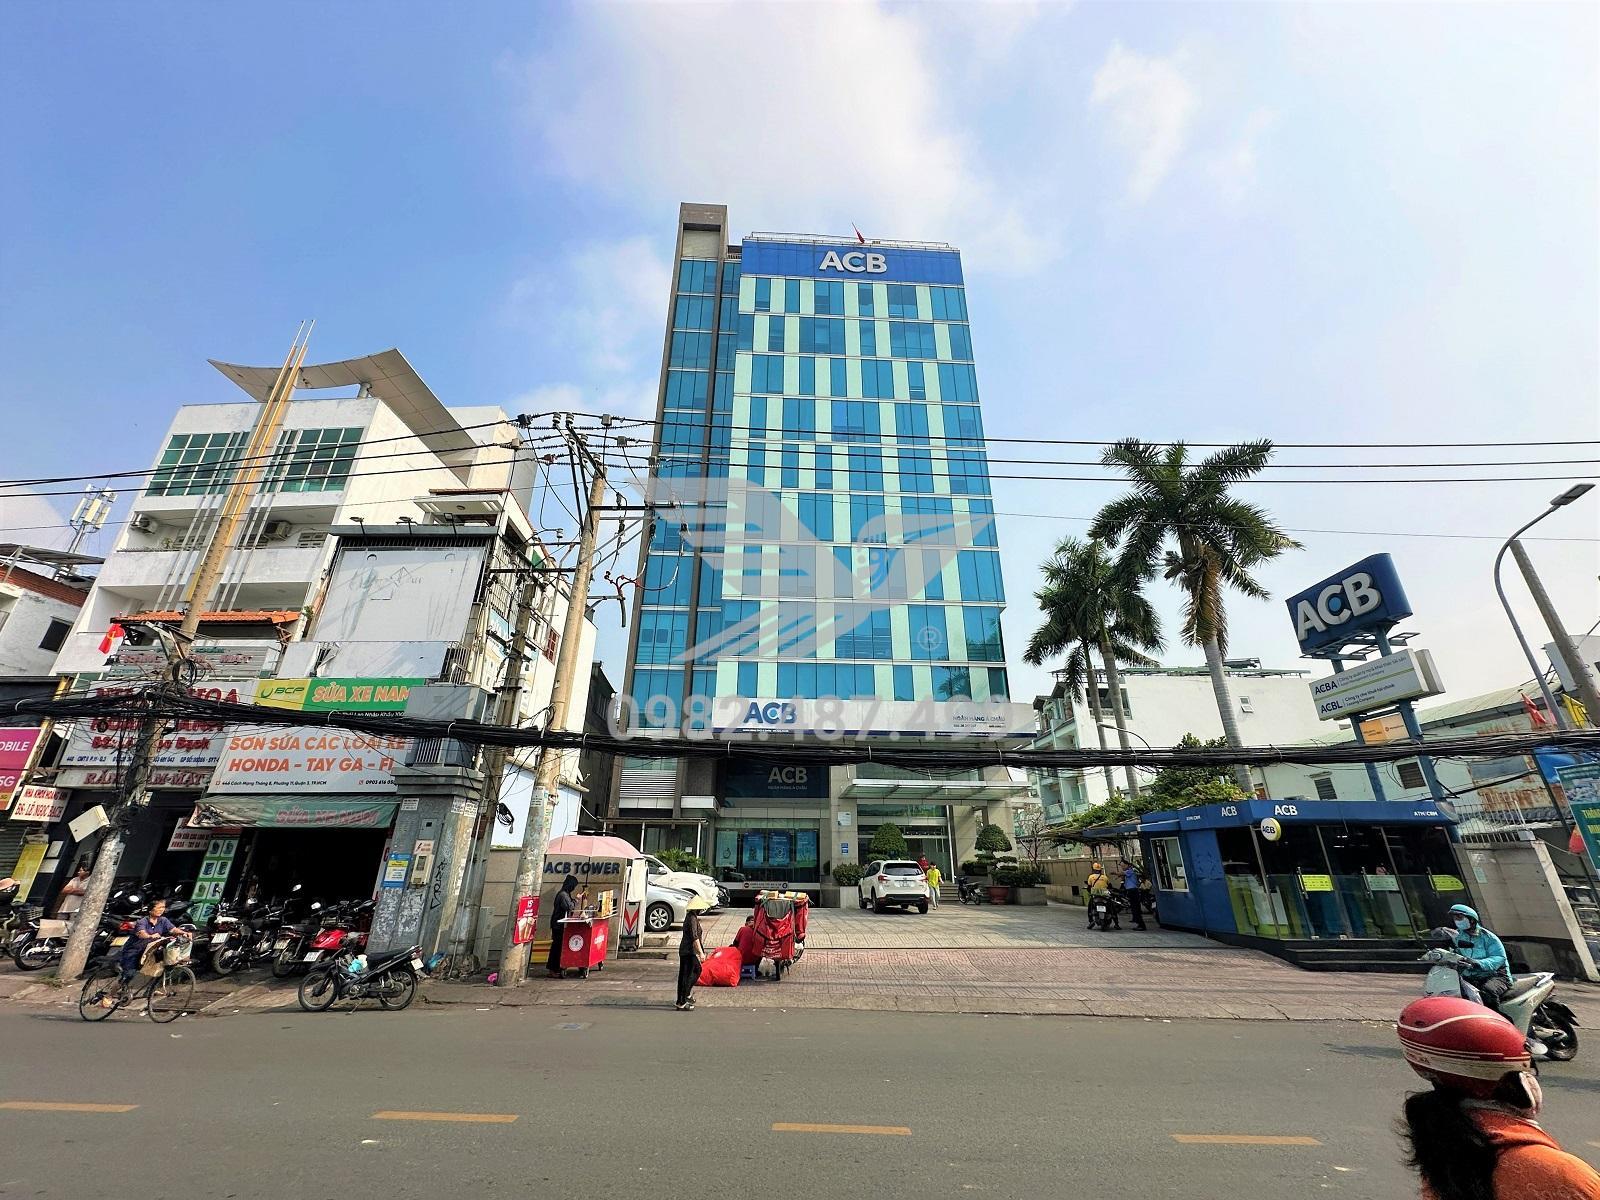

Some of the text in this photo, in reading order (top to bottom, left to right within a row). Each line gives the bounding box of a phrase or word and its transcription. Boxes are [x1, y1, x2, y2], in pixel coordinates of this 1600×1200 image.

[819, 250, 887, 273] ACB
[1297, 572, 1381, 641] ACB
[312, 681, 347, 702] SỬA
[349, 685, 373, 702] XE
[1315, 680, 1338, 695] ACBA
[743, 701, 797, 724] ACB
[1320, 700, 1343, 714] ACBL
[229, 736, 267, 751] SƠN
[268, 733, 301, 751] SỬA
[304, 732, 341, 751] CÁC
[229, 758, 289, 772] HONDA
[306, 758, 336, 772] TAY
[339, 757, 363, 772] GA
[768, 766, 808, 784] ACB
[1221, 805, 1238, 817] ACB
[1274, 804, 1298, 816] ACB
[1262, 825, 1276, 834] ACB
[544, 861, 621, 875] ACB TOWER
